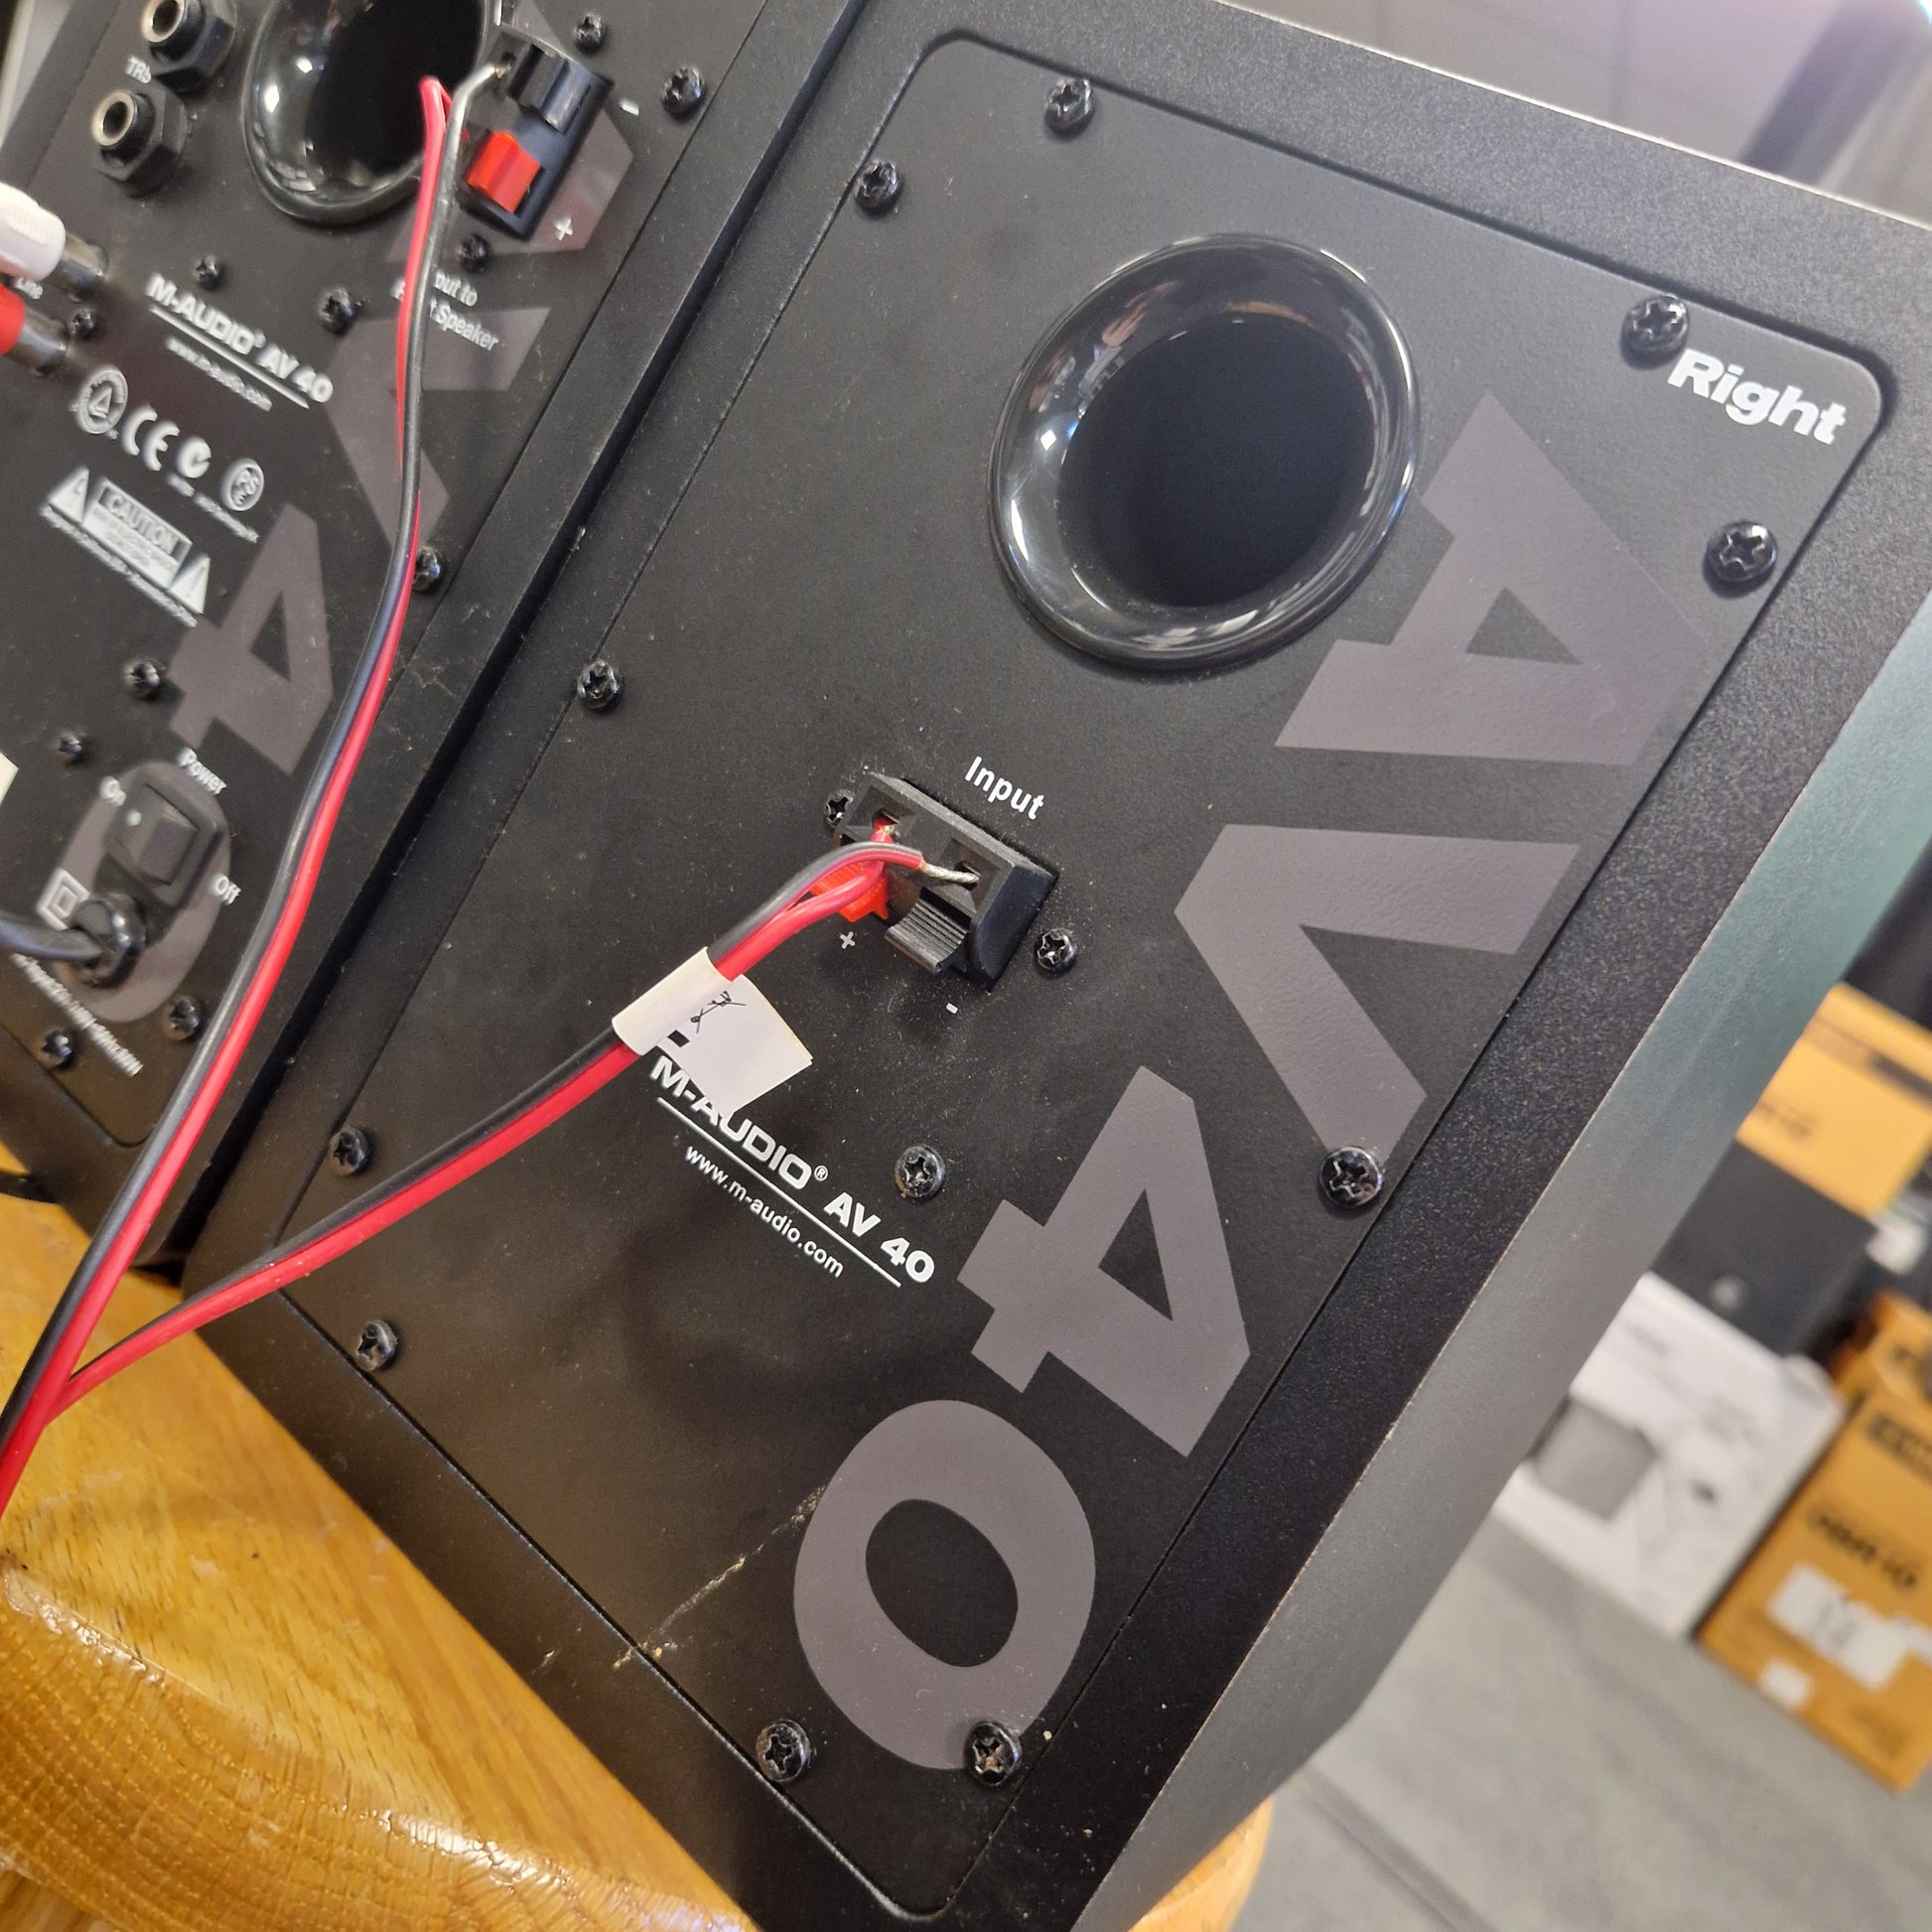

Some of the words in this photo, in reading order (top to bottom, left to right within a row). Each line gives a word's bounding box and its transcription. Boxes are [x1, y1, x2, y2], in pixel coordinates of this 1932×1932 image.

[460, 279, 479, 307] to
[435, 301, 499, 351] Speaker
[255, 344, 300, 380] AV
[290, 364, 335, 403] 40
[1668, 348, 1847, 445] Right
[106, 492, 181, 555] CAUTION
[177, 747, 227, 794] Power
[965, 756, 1044, 820] Input
[210, 873, 241, 905] Off
[685, 1145, 844, 1279] www.m-audio.com
[823, 1191, 882, 1237] AV
[880, 1236, 935, 1284] 40
